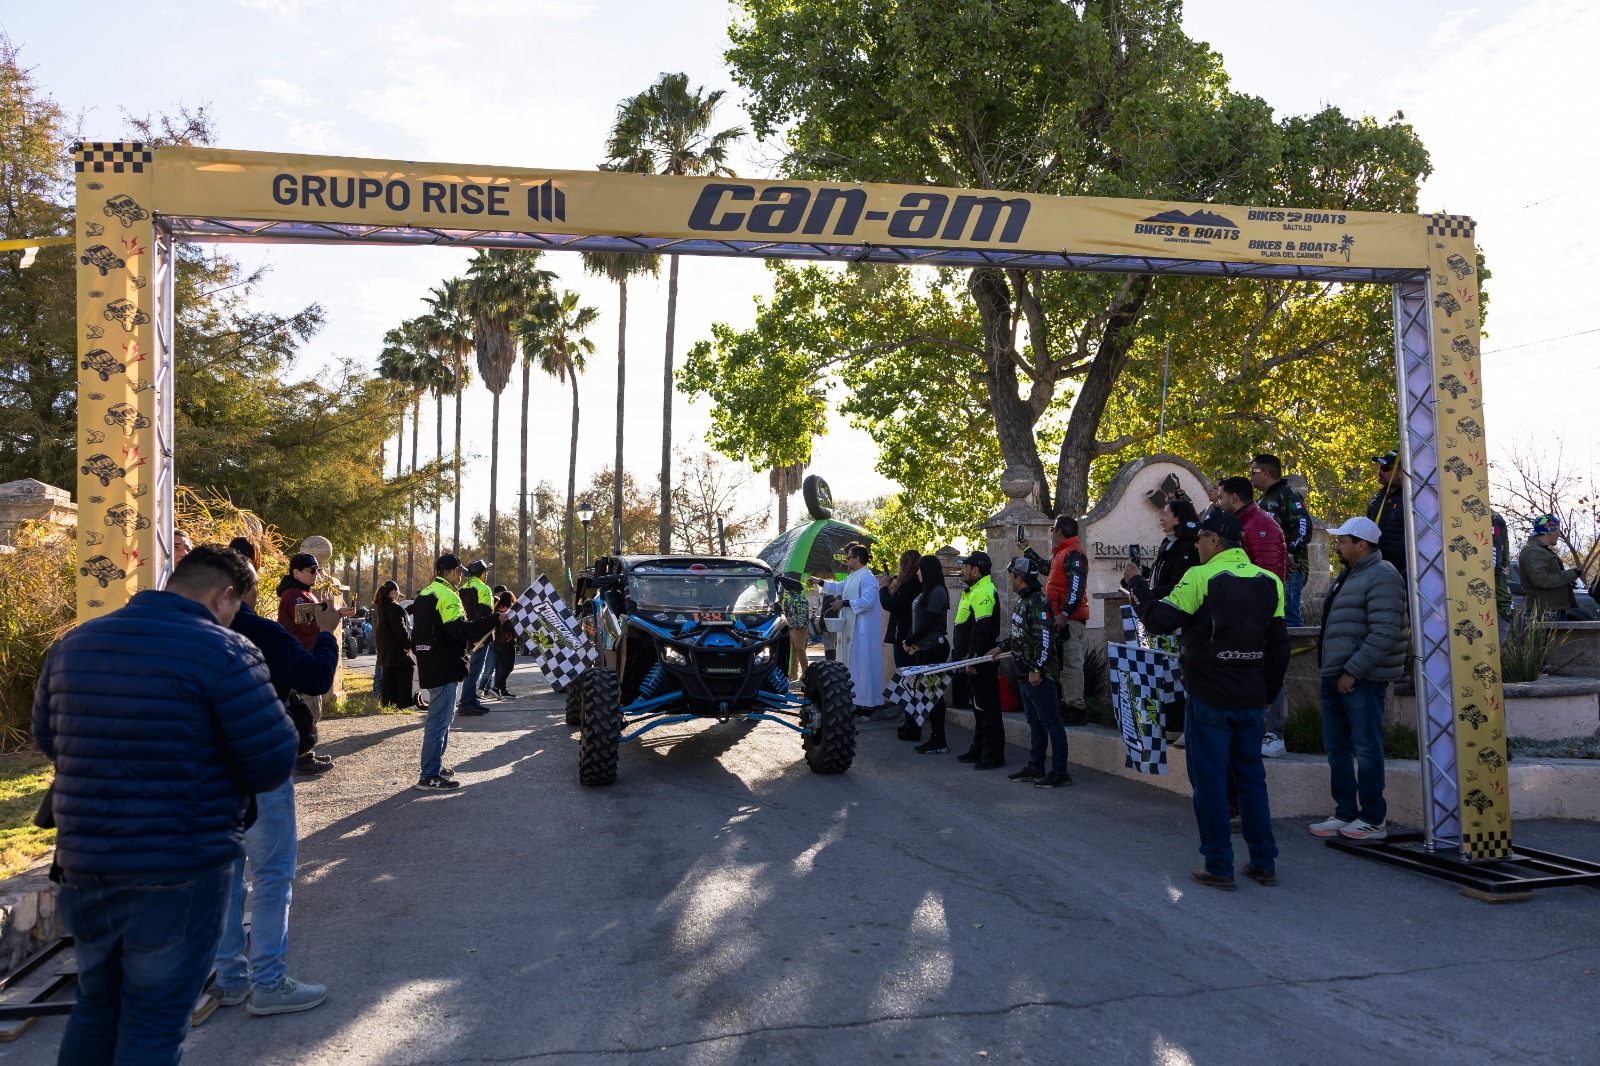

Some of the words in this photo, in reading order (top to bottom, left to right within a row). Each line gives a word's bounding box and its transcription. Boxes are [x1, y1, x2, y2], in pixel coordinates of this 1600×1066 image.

[272, 173, 411, 212] GRUPO
[422, 182, 510, 216] RISE
[688, 183, 1032, 243] can-am
[1247, 210, 1285, 222] BIKES
[1303, 213, 1347, 225] BOATS
[1134, 223, 1175, 236] BIKES
[1178, 226, 1190, 238] &
[1194, 227, 1241, 241] BOATS
[1282, 223, 1312, 232] SALTILLO
[1248, 239, 1283, 251] BIKES
[1285, 241, 1296, 251] &
[1298, 241, 1338, 253] BOATS
[1261, 250, 1282, 258] PLAYA
[1282, 251, 1296, 259] DEL
[1296, 252, 1324, 260] CARMEN
[1093, 541, 1149, 556] RINCN
